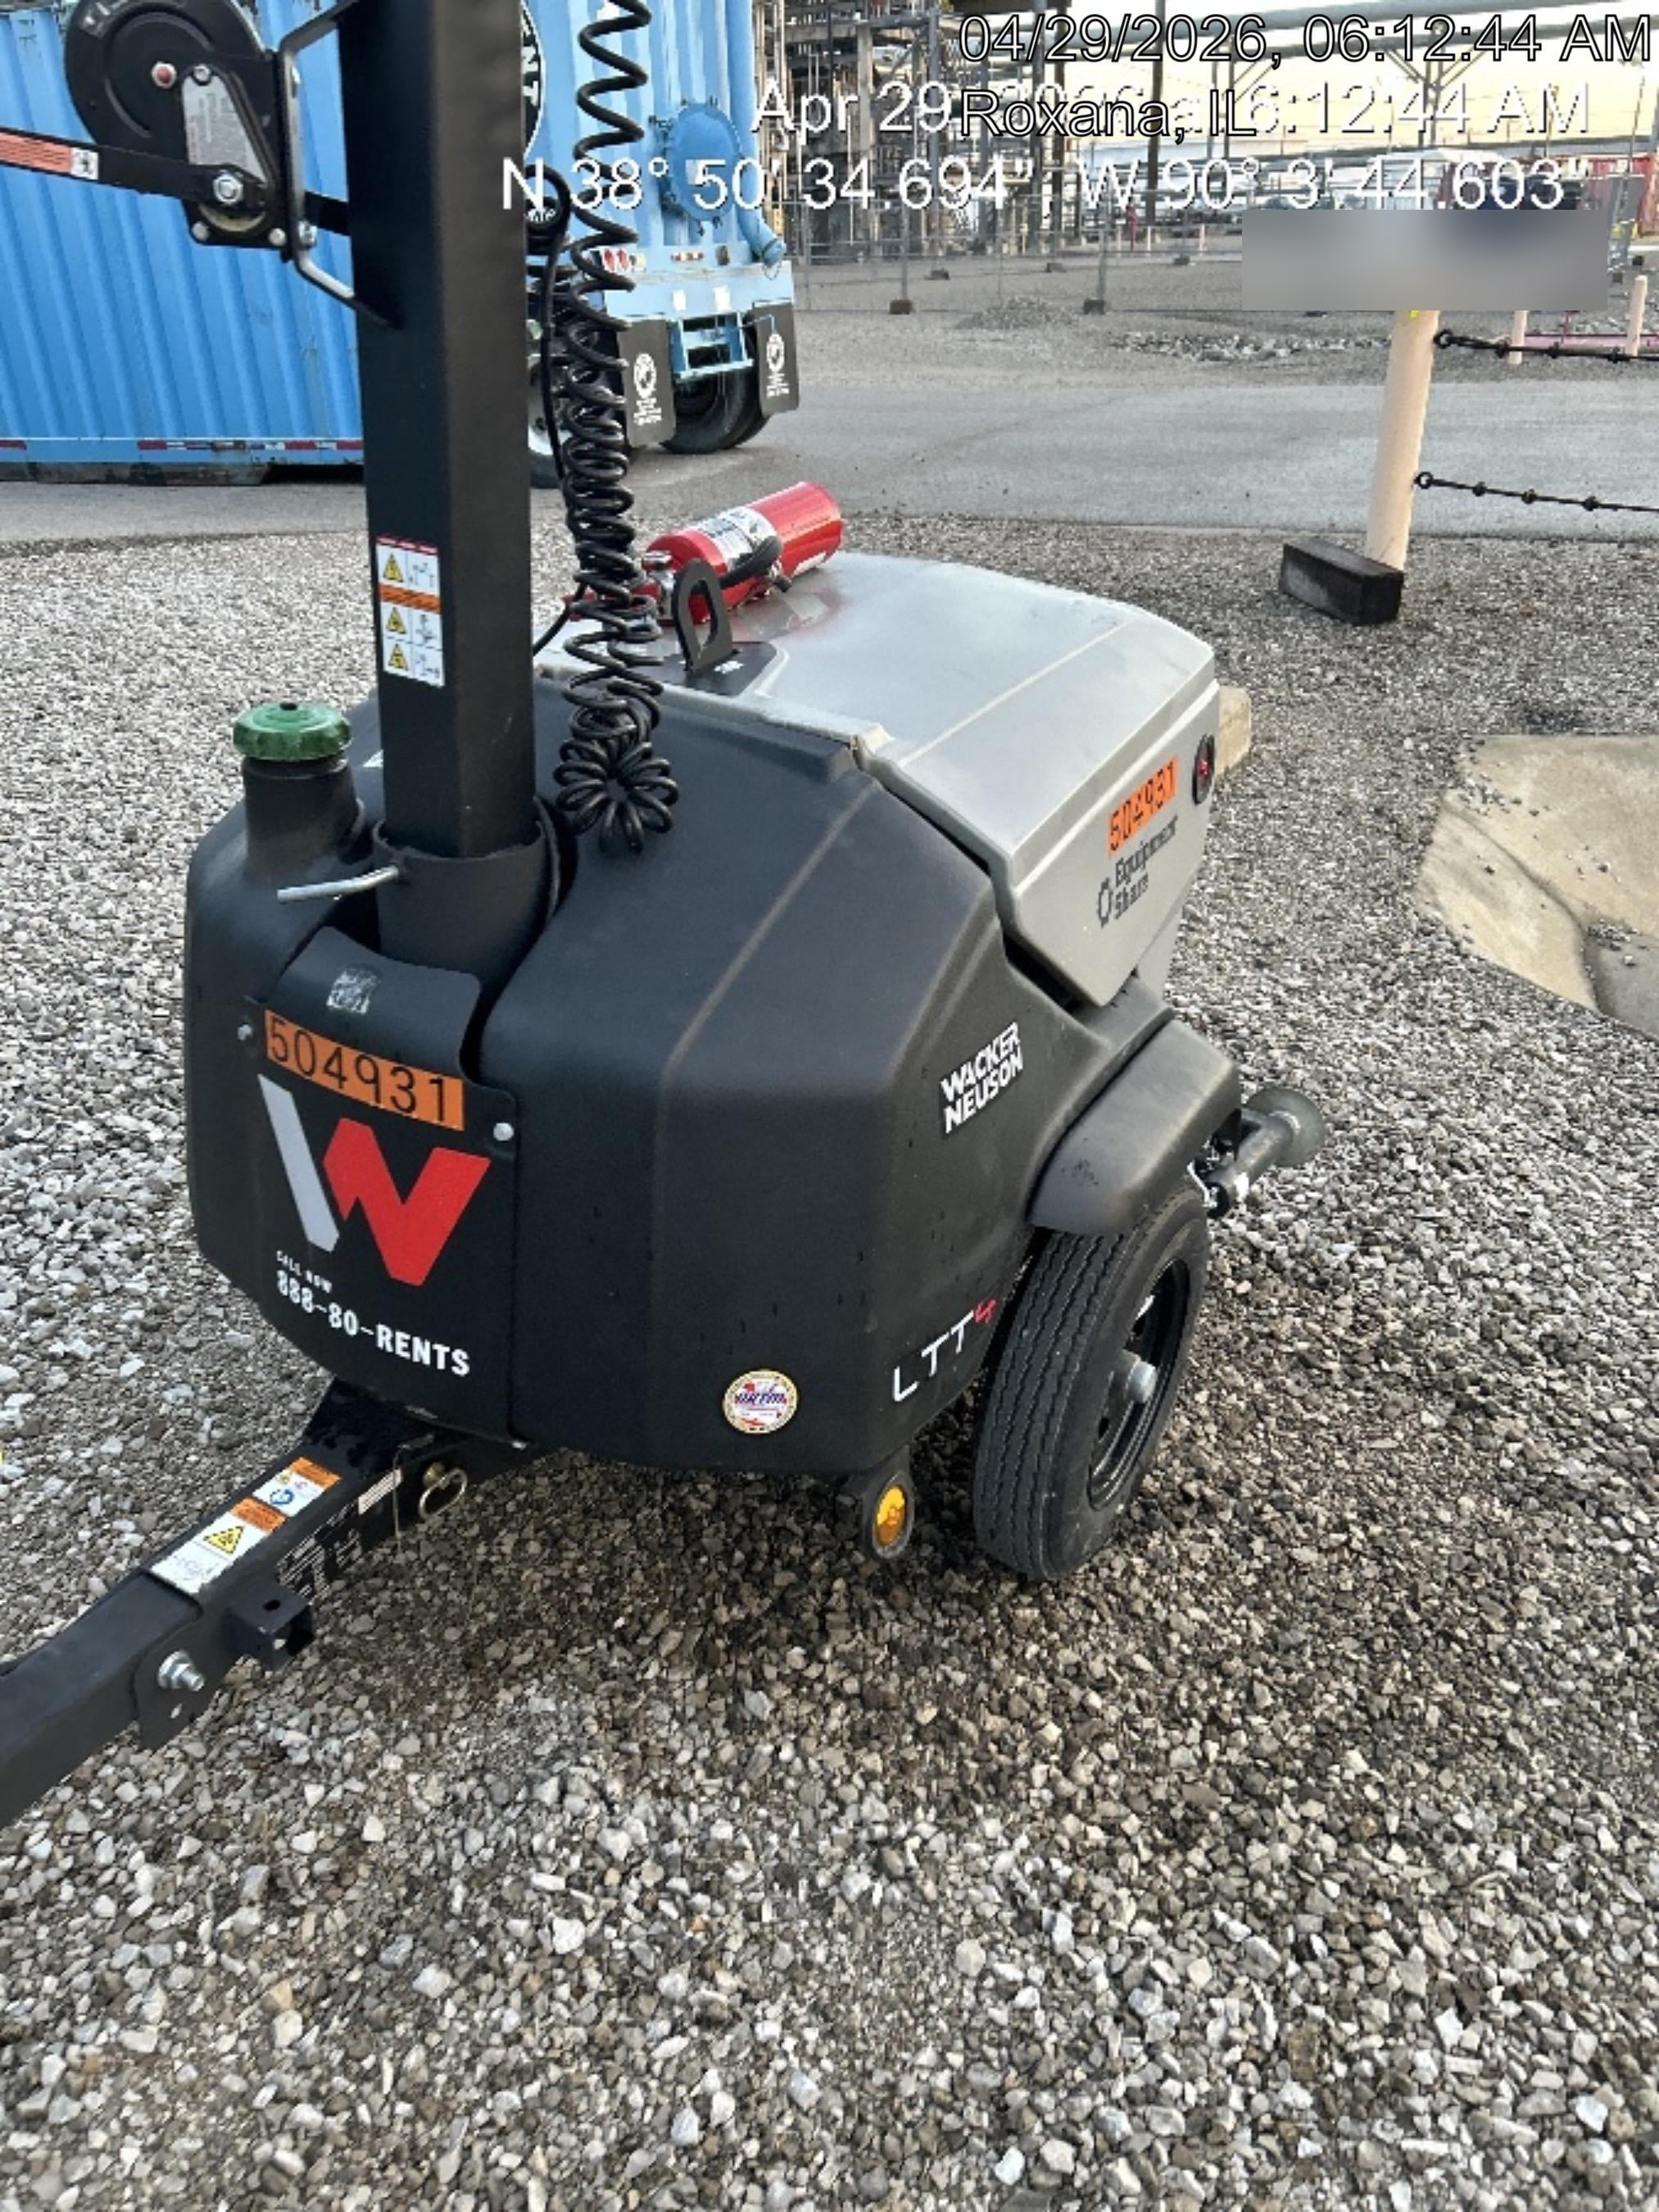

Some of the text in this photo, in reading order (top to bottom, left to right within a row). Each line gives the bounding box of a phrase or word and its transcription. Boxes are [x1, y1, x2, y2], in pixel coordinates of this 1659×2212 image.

[269, 1015, 446, 1122] 504931
[941, 1021, 1021, 1102] WACKER
[944, 1045, 1023, 1135] NEUSON
[276, 1270, 471, 1378] 888-80-RENTS
